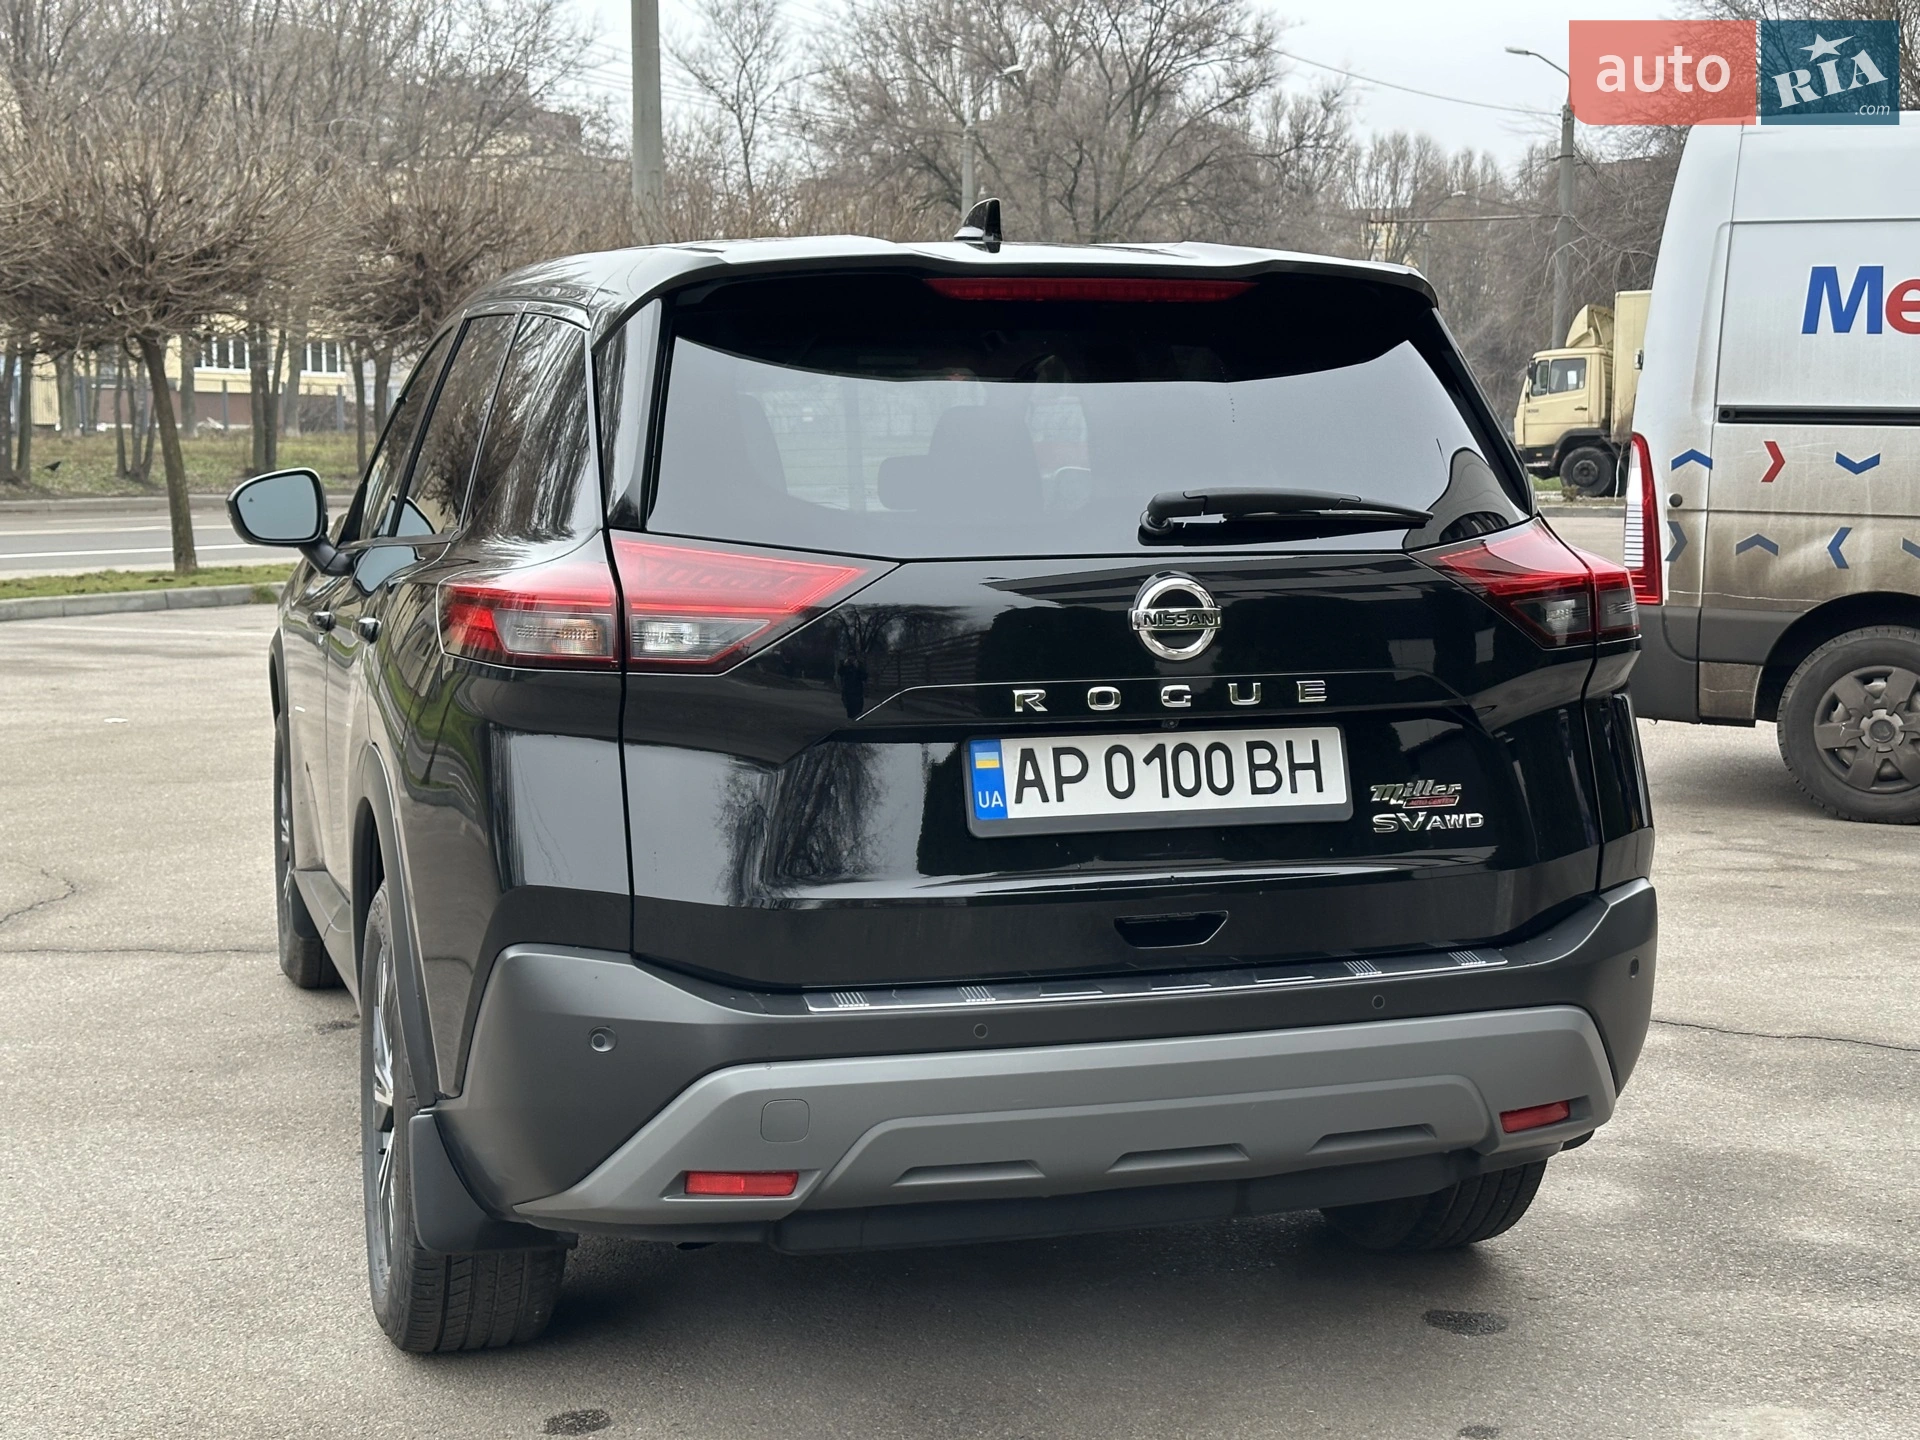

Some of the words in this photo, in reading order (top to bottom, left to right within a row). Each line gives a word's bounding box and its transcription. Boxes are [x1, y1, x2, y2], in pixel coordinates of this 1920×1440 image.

[1143, 612, 1216, 627] NISSAN
[1012, 680, 1328, 713] ROGUE
[1014, 746, 1089, 804] AP
[1103, 741, 1235, 800] 0100
[1245, 738, 1324, 795] BH
[978, 789, 1004, 809] UA
[1372, 811, 1427, 834] SV
[1425, 812, 1485, 831] AWD
